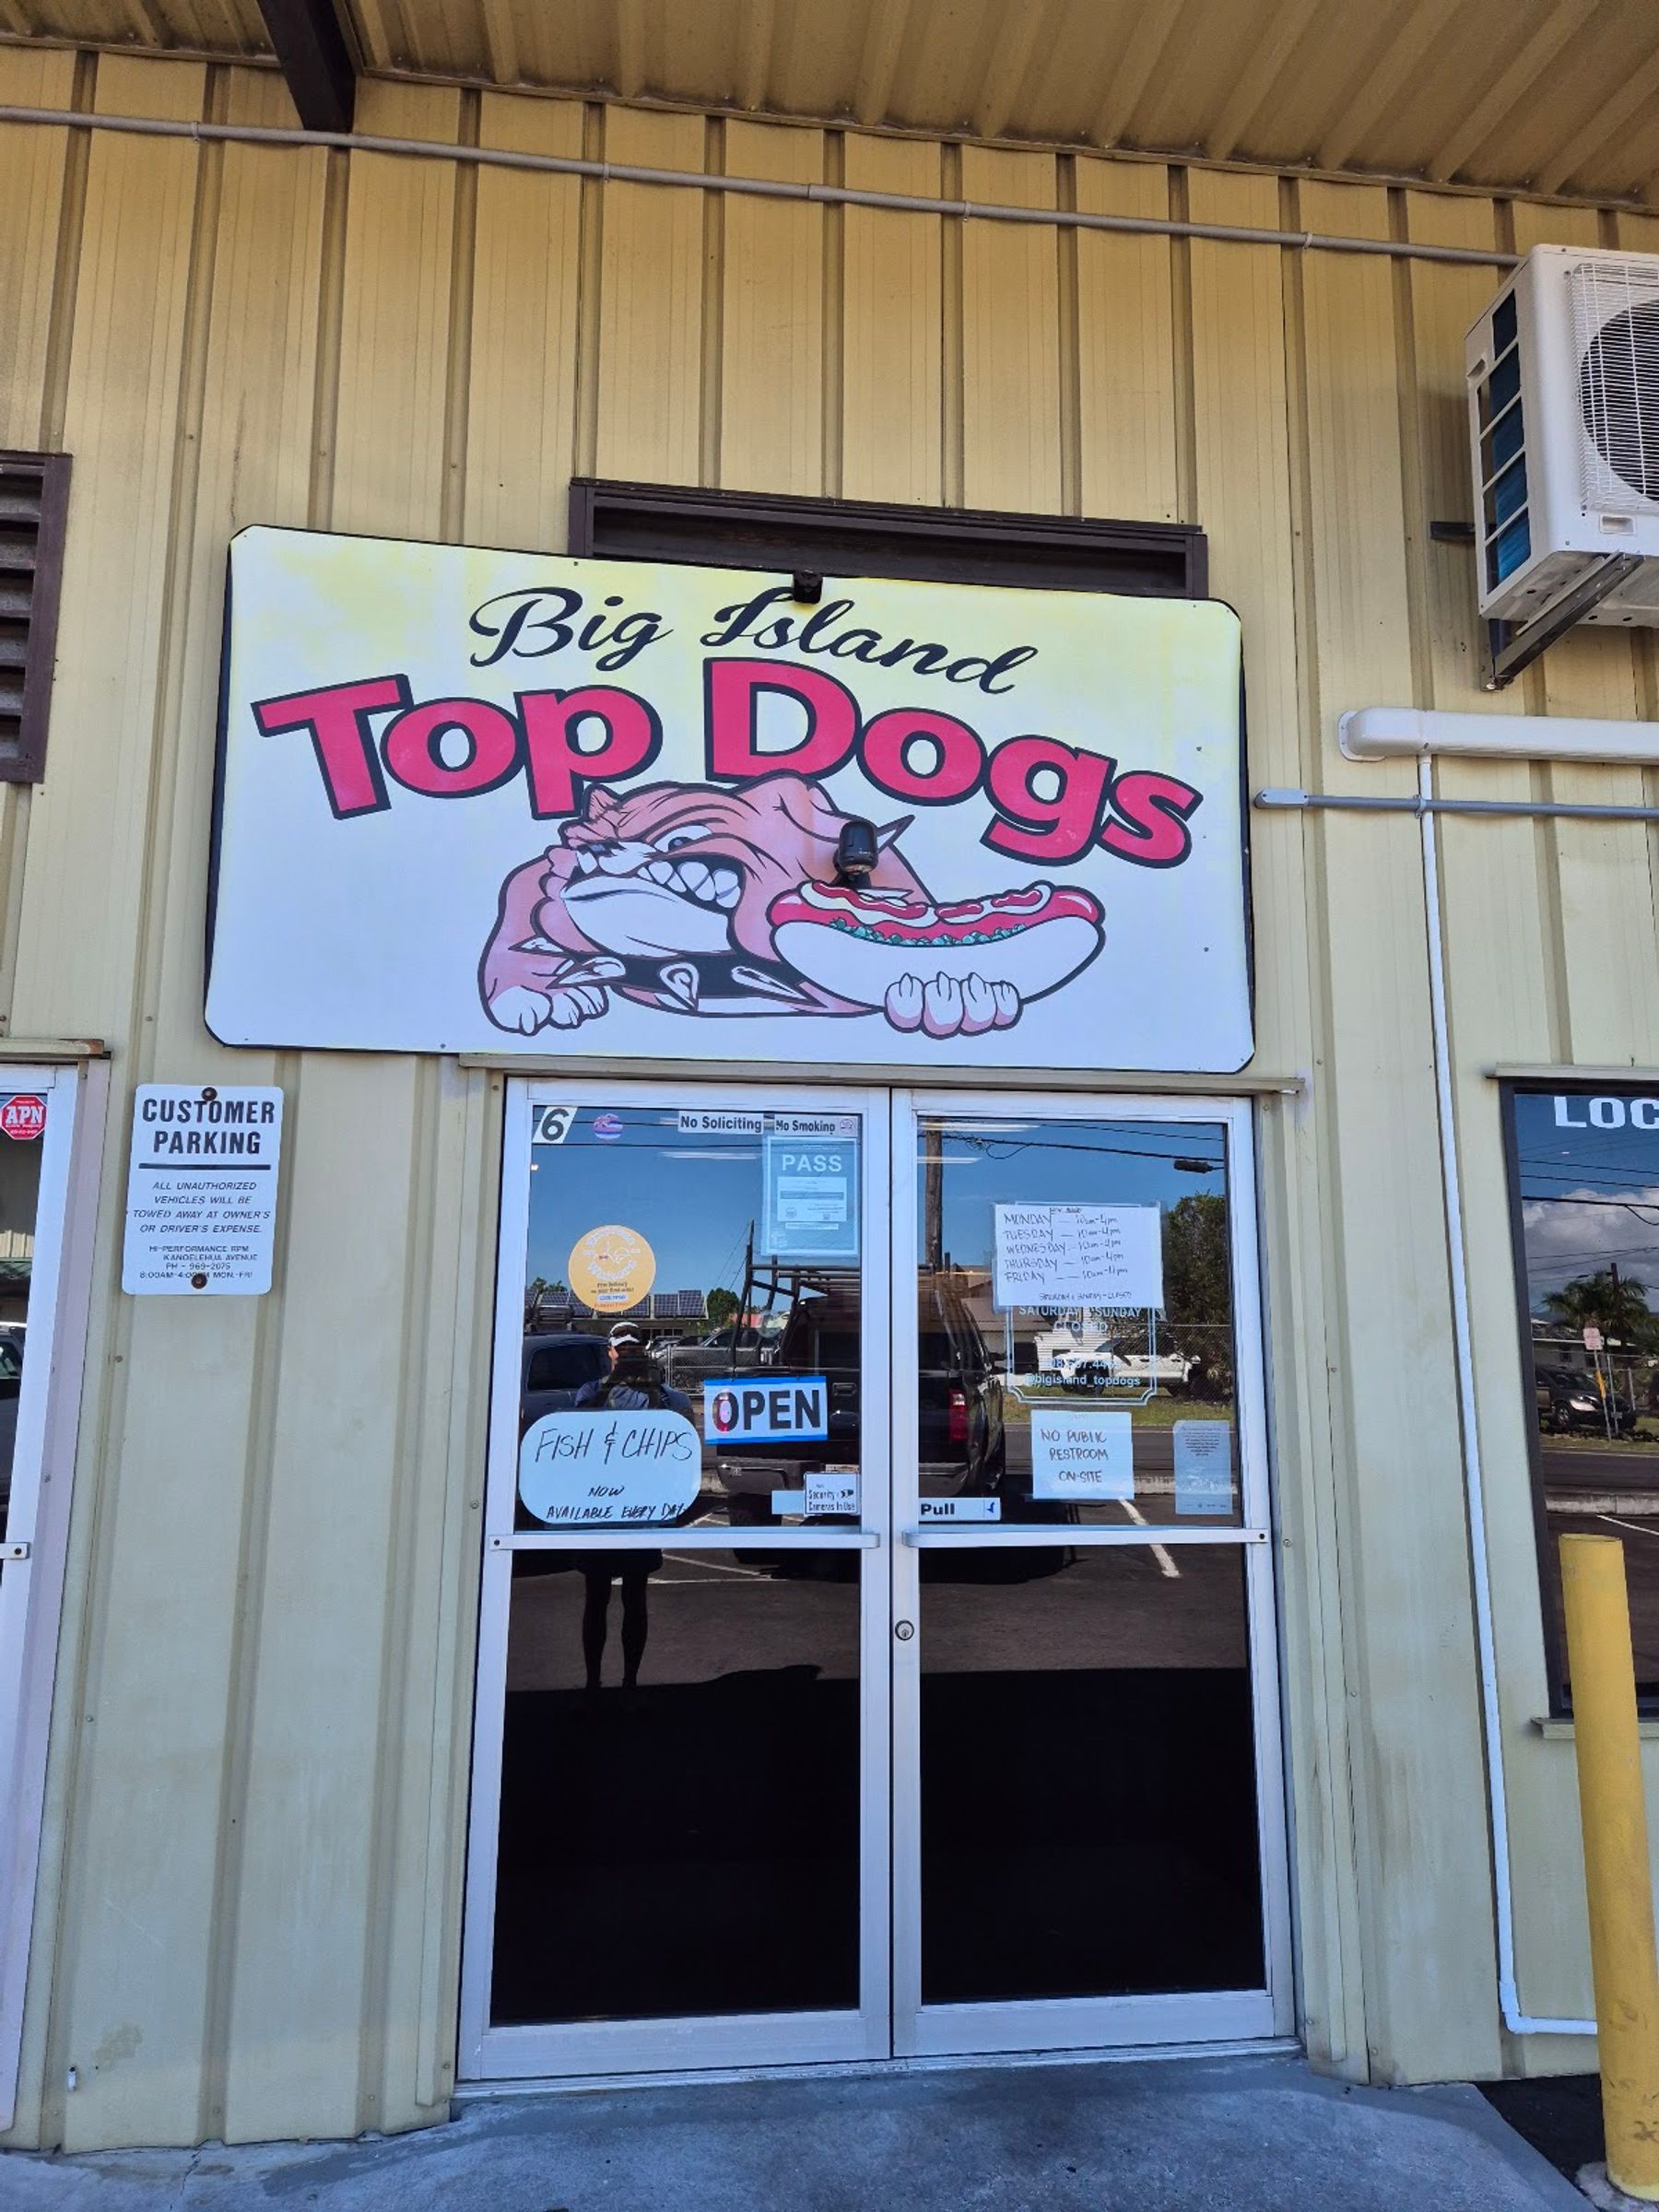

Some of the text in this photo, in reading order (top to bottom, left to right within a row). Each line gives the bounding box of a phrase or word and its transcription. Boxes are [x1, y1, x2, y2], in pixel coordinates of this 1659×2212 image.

[469, 584, 1039, 695] Big Island
[253, 657, 1204, 869] Top Dogs
[6, 1106, 44, 1124] APN
[142, 1099, 276, 1124] CUSTOMER
[540, 1108, 570, 1142] 6
[680, 1115, 762, 1134] No Soliciting
[792, 1120, 836, 1135] Smoking
[153, 1131, 261, 1154] PARKING
[782, 1154, 842, 1172] PASS
[152, 1182, 257, 1190] ALL UNAUTHORIZED
[154, 1195, 206, 1205] VEHICLES
[133, 1209, 171, 1218] TOWED
[175, 1210, 203, 1219] AWAY
[1004, 1212, 1053, 1226] MONDAY
[139, 1224, 156, 1233] OR
[159, 1225, 208, 1233] DRIVER'S
[1003, 1229, 1053, 1241] TUESDAY
[1006, 1243, 1066, 1256] WEDNESDAY
[1004, 1258, 1058, 1272] THURSDAY
[1005, 1271, 1045, 1285] FRIDAY
[1097, 1308, 1141, 1318] SUNDAY
[712, 1389, 821, 1432] OPEN
[1041, 1429, 1062, 1442] NO
[535, 1428, 594, 1463] FISH
[622, 1428, 693, 1461] CHIPS
[1050, 1447, 1108, 1461] RESTROOM
[588, 1485, 625, 1497] NOW
[546, 1504, 614, 1519] AVAILABLE
[620, 1504, 657, 1520] EVERY
[921, 1503, 956, 1517] Pull
